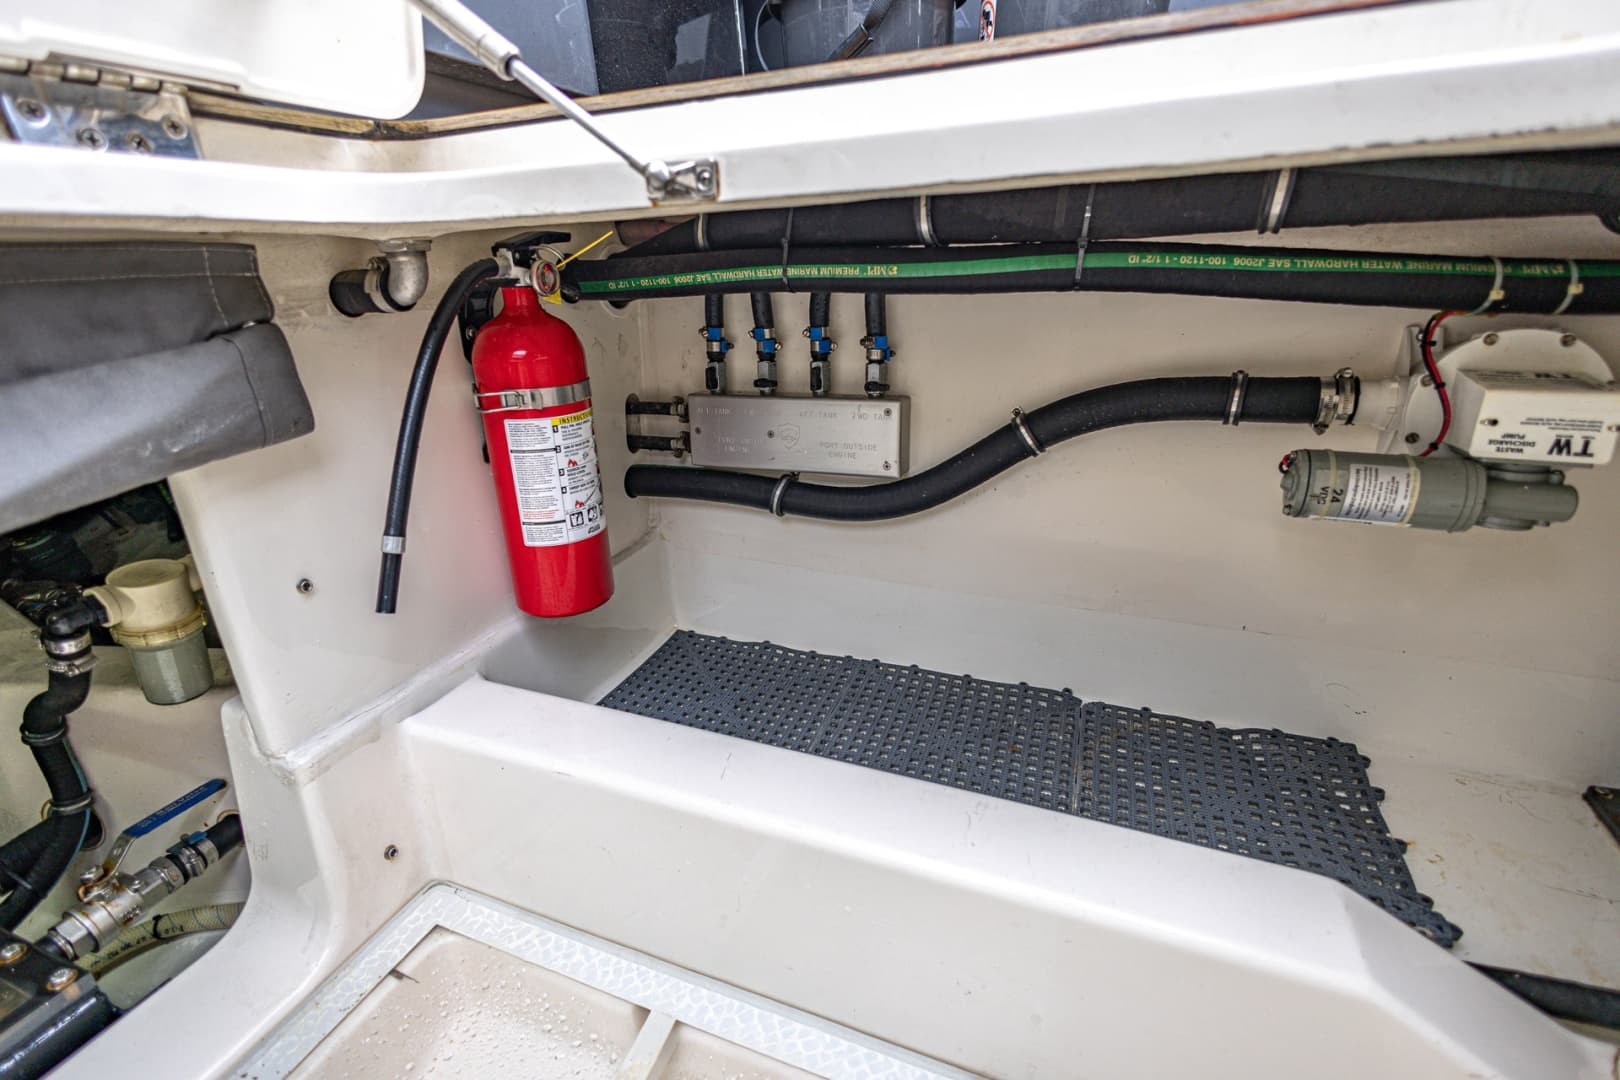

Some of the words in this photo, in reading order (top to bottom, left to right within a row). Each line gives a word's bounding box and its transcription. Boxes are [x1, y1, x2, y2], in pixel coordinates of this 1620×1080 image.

[1128, 255, 1139, 264] ID
[1180, 256, 1226, 265] 100-1120
[1233, 257, 1264, 267] J2006
[1267, 258, 1290, 268] SAE
[1295, 259, 1358, 269] HARDWALL
[1361, 260, 1403, 269] WATER
[820, 265, 860, 276] PREMIUM
[1407, 261, 1453, 271] MARINE
[1456, 262, 1513, 272] PEMIUM
[712, 269, 756, 281] HARDWALL
[756, 268, 783, 278] WATER
[786, 266, 819, 277] MARINE
[697, 273, 711, 283] SAE
[1501, 432, 1525, 440] PUMP
[1488, 439, 1536, 448] DISCHARGE
[1546, 438, 1594, 458] TW
[1495, 446, 1524, 454] WASTE
[1317, 485, 1330, 505] VDC
[1331, 488, 1343, 503] 24
